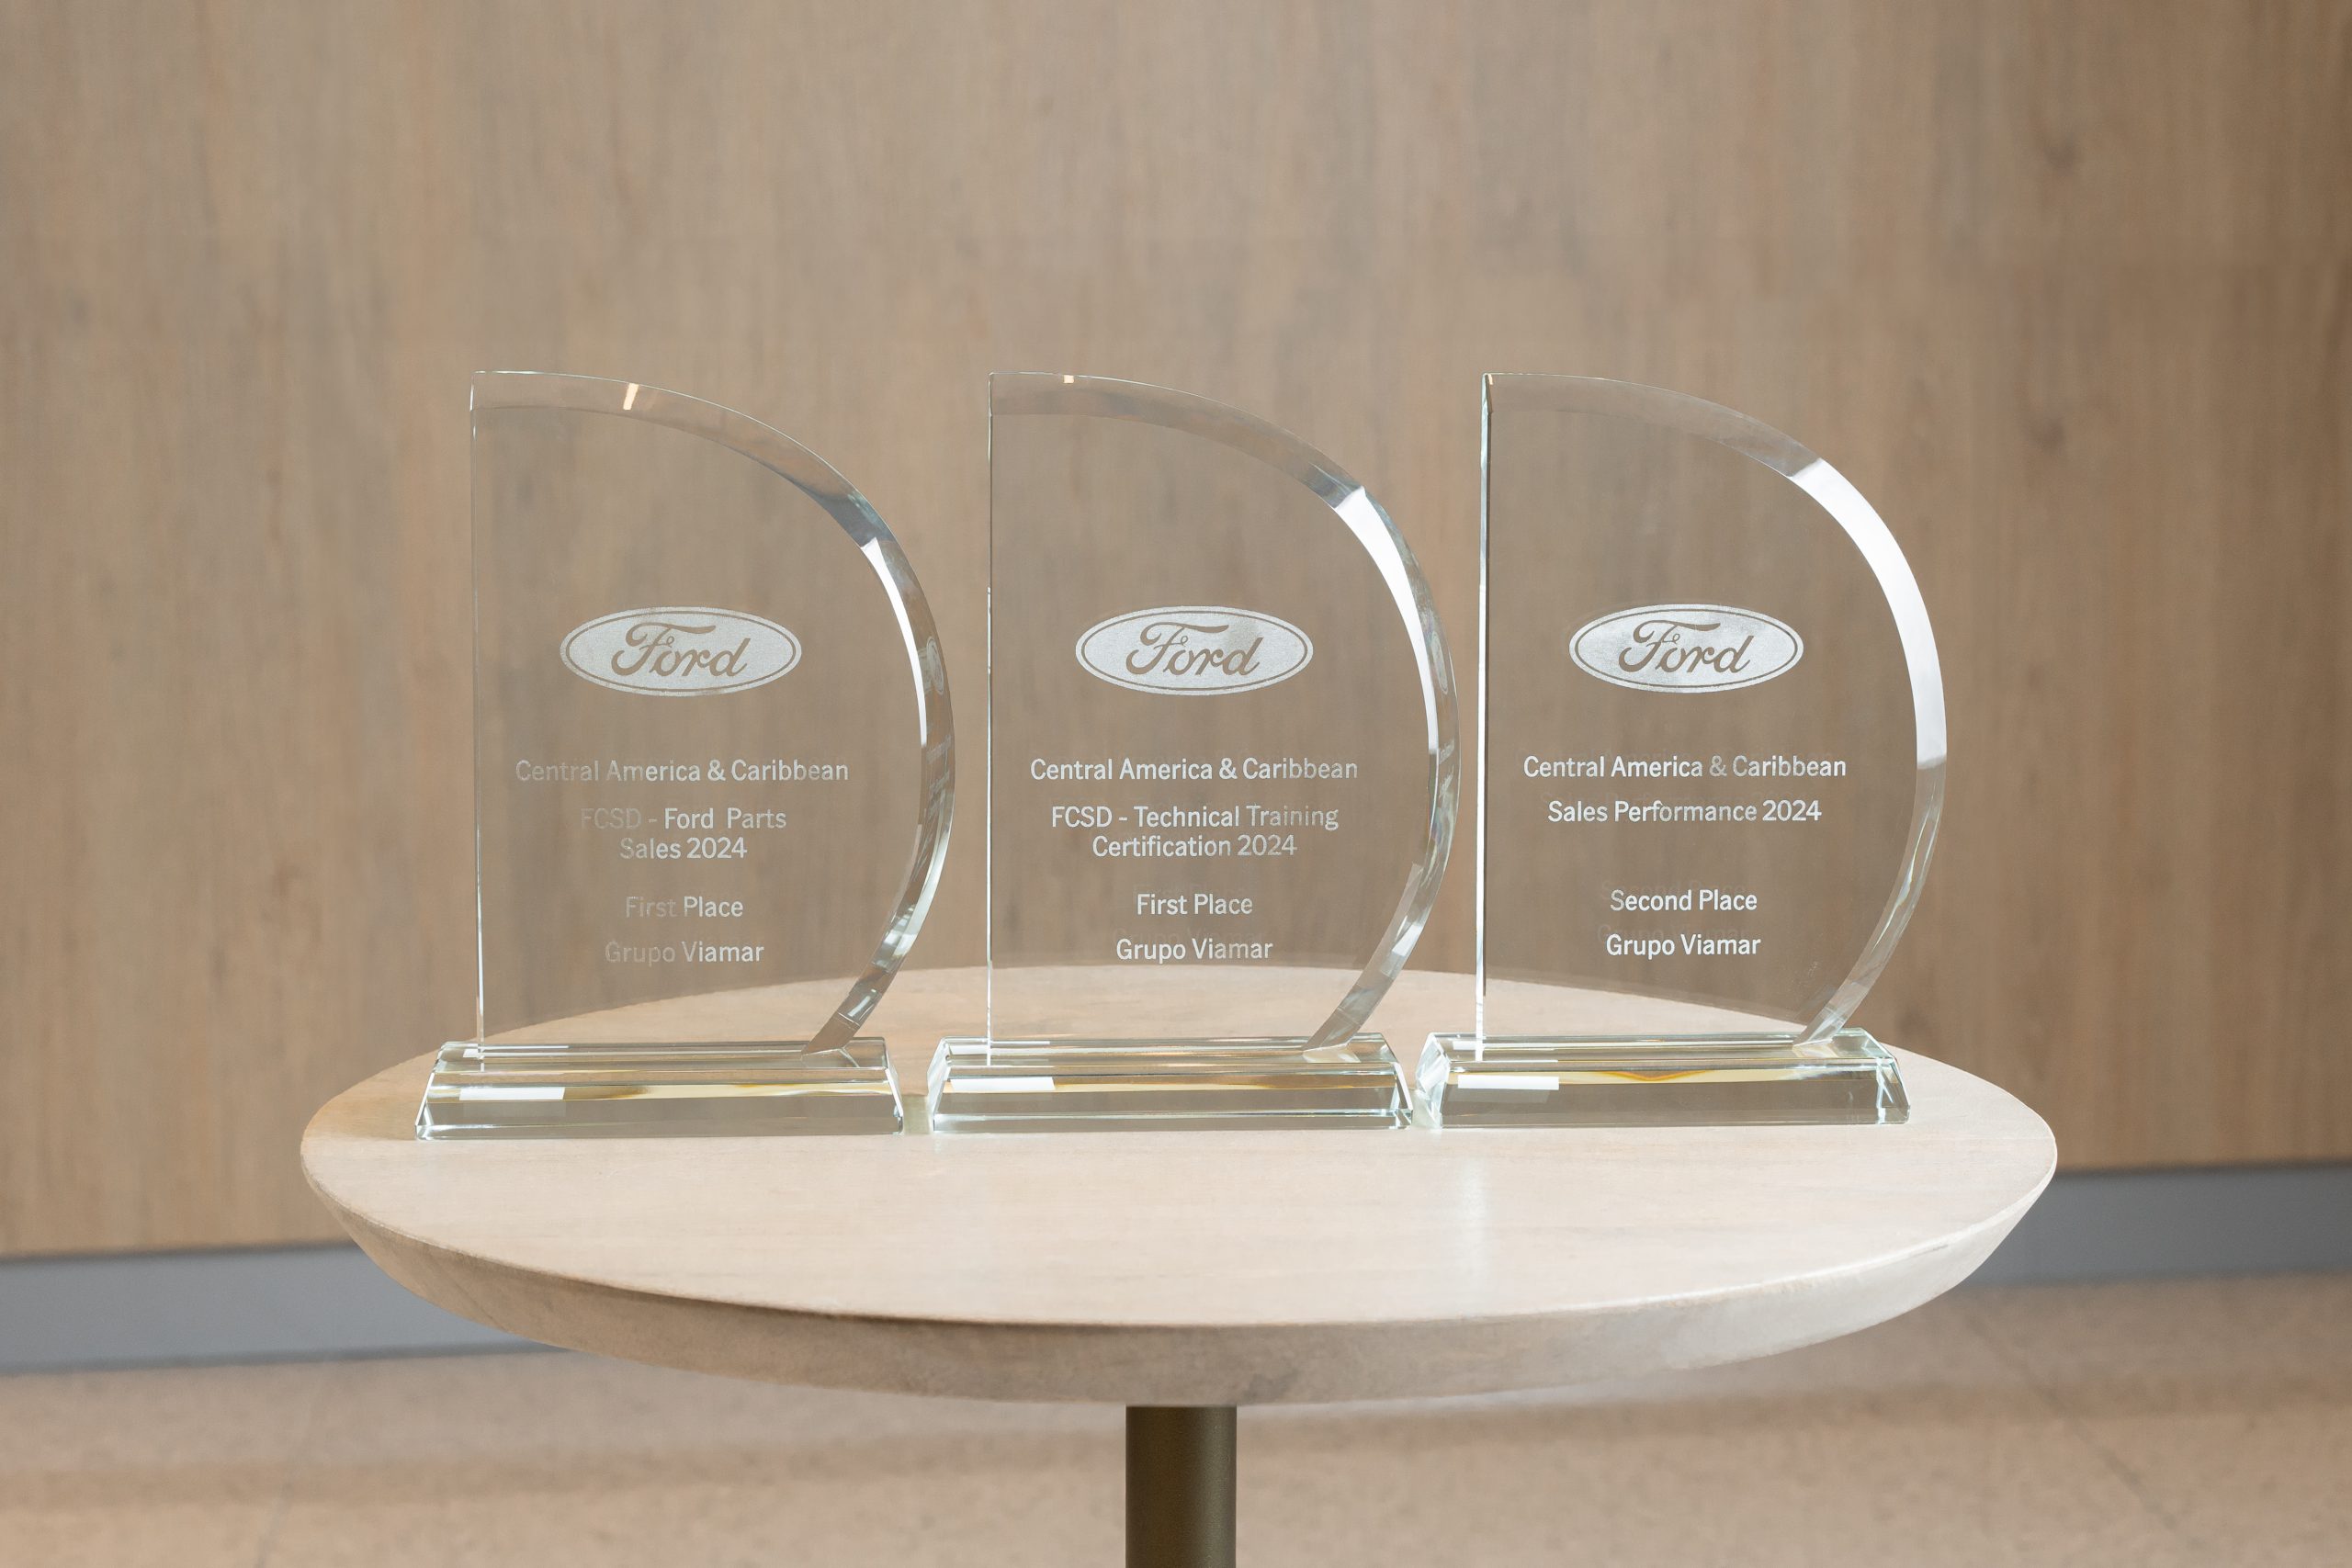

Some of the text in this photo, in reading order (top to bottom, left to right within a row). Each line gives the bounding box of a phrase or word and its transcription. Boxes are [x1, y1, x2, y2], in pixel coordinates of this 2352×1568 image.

[611, 622, 751, 676] Ford
[1126, 622, 1264, 675] Ford
[1619, 620, 1754, 673] Ford
[515, 759, 849, 781] Central America & Caribbean
[1031, 758, 1358, 780] Central America & Caribbean
[1523, 755, 1847, 777] Central America & Caribbean
[581, 807, 641, 829] FCSD
[664, 807, 714, 829] Ford
[727, 807, 786, 829] Parts
[1052, 807, 1112, 828] FCSD
[1134, 806, 1239, 828] Technical
[1246, 804, 1339, 830] Training
[1548, 800, 1822, 822] Sales Performance 2024
[620, 837, 747, 859] Sales 2024
[1092, 834, 1297, 857] Certification 2024
[626, 896, 743, 918] First Place
[1137, 893, 1252, 915] First Place
[1610, 889, 1757, 911] Second Place
[605, 942, 764, 966] Grupo Viamar
[1116, 938, 1273, 964] Grupo Viamar
[1606, 933, 1761, 959] Grupo Viamar
